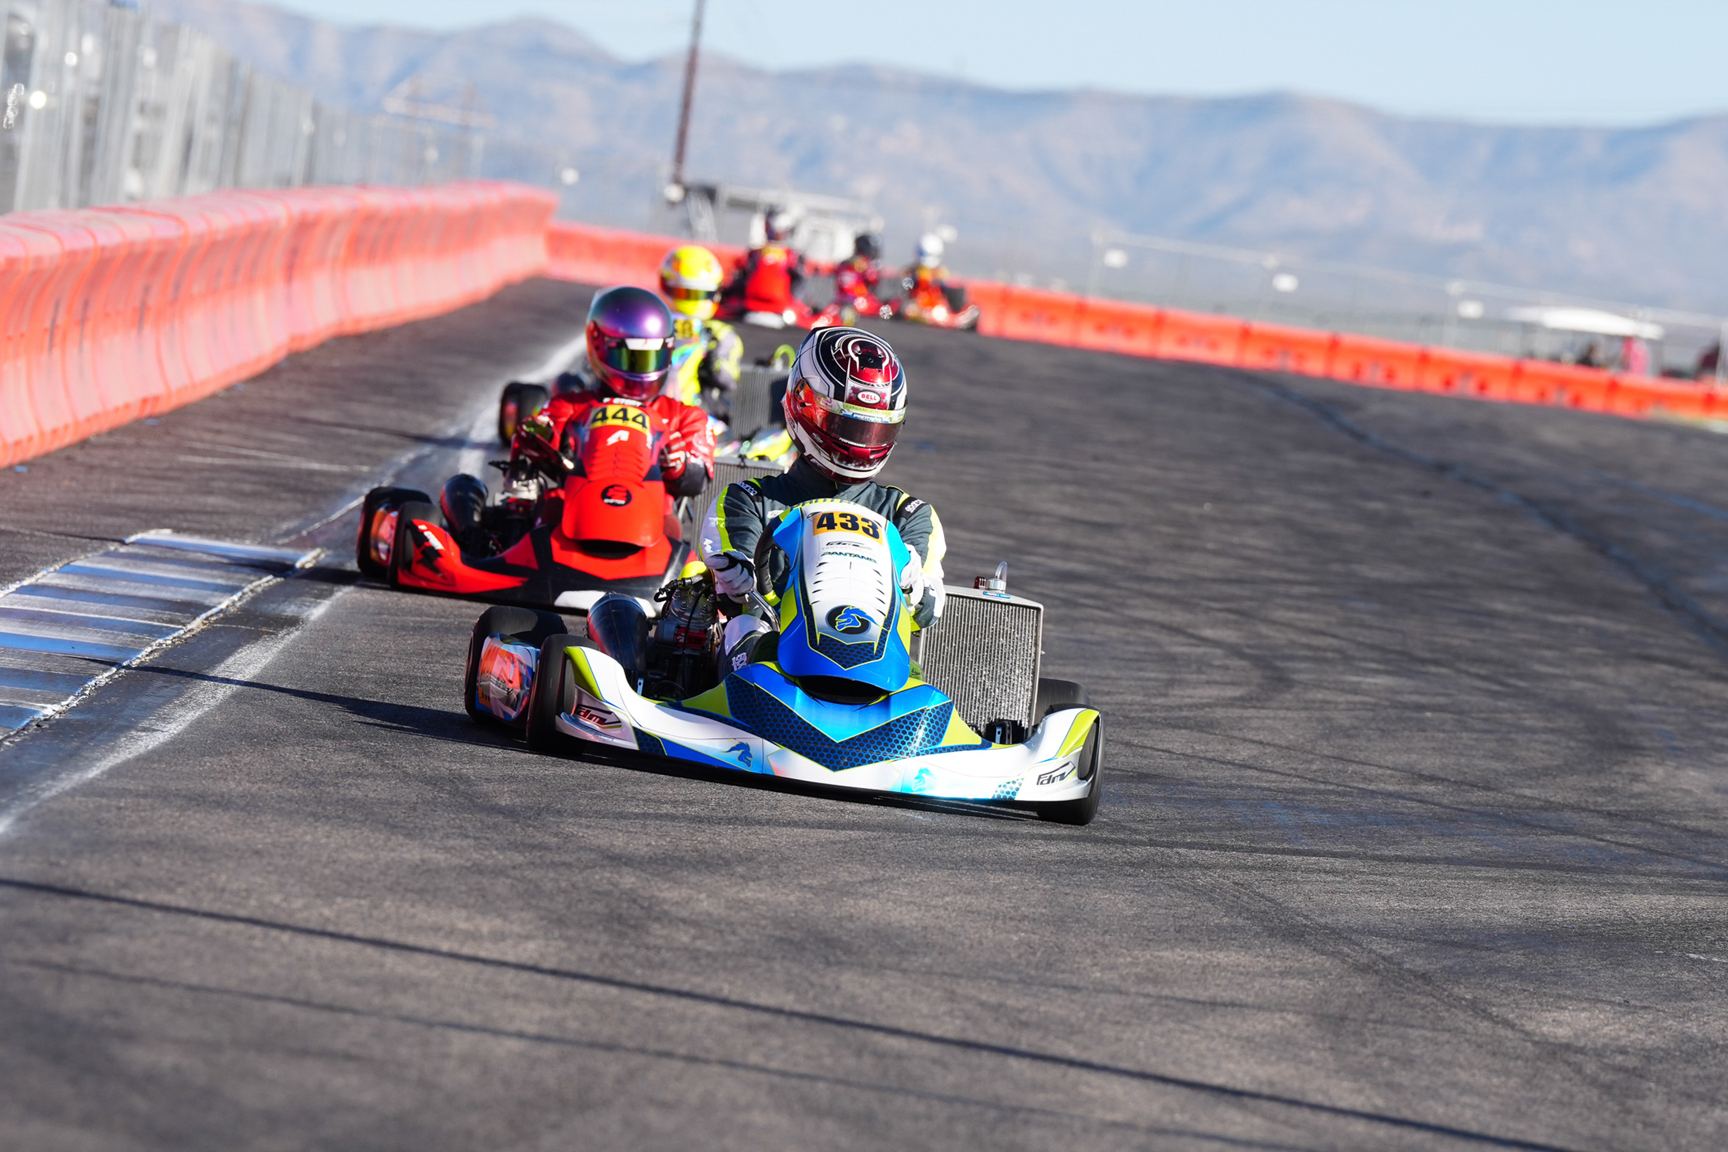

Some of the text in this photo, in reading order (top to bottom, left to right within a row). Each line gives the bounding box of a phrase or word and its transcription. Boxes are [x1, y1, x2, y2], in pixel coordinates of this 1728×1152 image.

[861, 393, 877, 401] BELL
[591, 407, 648, 429] 444
[816, 512, 880, 540] 433
